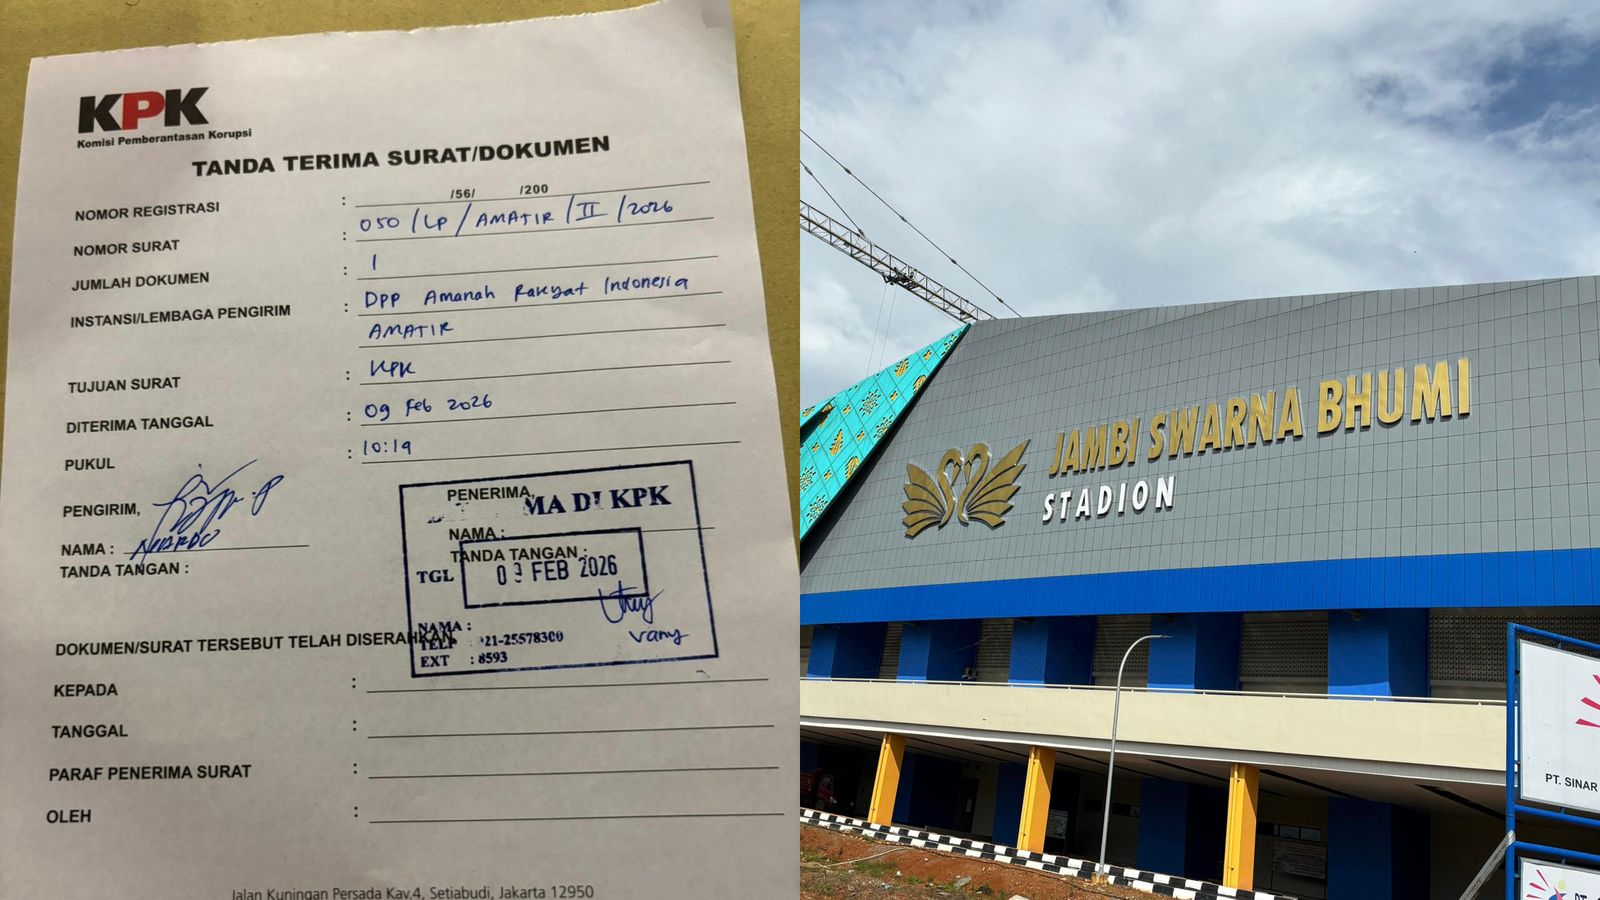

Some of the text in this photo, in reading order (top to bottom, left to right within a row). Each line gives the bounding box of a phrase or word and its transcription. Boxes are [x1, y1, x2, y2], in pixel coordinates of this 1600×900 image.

[78, 87, 210, 134] KPK
[76, 128, 252, 149] Komisi Pemberantasan Korupsi
[192, 135, 610, 177] TANDA TERIMA SURAT/DOKUMEN
[75, 207, 129, 222] NOMOR
[132, 201, 220, 218] REGISTRASI
[450, 188, 476, 200] /56/
[519, 184, 549, 195] /200
[73, 243, 128, 257] NOMOR
[131, 239, 180, 253] SURAT
[71, 277, 131, 292] JUMLAH
[135, 271, 210, 288] DOKUMEN
[423, 285, 496, 306] Amanah
[603, 275, 689, 293] Indonesia
[70, 309, 214, 328] INSTANSI/LEMBAGA
[217, 304, 291, 319] PENGIRIM
[368, 321, 455, 340] AMATIR
[68, 380, 126, 394] TUJUAN
[131, 376, 181, 390] SURAT
[365, 403, 390, 421] 09
[447, 394, 493, 412] 2026
[66, 419, 137, 434] DITERIMA
[141, 415, 214, 431] TANGGAL
[1048, 357, 1473, 478] JAMBI SWARNA BHUMI
[65, 457, 115, 471] PUKUL
[447, 485, 534, 502] PENERIMA,
[611, 484, 671, 509] KPK
[1042, 475, 1176, 522] STADION
[62, 502, 140, 517] PENGIRIM,
[449, 528, 496, 541] NAMA
[61, 543, 105, 556] NAMA
[450, 549, 505, 563] TANDA
[509, 545, 578, 561] TANGAN
[60, 564, 111, 578] TANDA
[115, 561, 180, 576] TANGAN
[416, 570, 454, 583] TGL
[532, 560, 569, 582] FEB
[579, 555, 618, 578] 2026
[418, 621, 463, 634] NAMA
[56, 640, 193, 656] DOKUMEN/SURAT
[197, 637, 283, 652] TERSEBUT
[287, 634, 341, 648] TELAH
[420, 655, 450, 668] EXT
[478, 652, 508, 664] 8593
[54, 684, 118, 697] KEPADA
[52, 725, 128, 738] TANGGAL
[49, 767, 103, 782] PARAF
[108, 766, 192, 780] PENERIMA
[197, 764, 252, 778] SURAT
[1545, 773, 1598, 791] PT. SINAR
[46, 810, 92, 824] OLEH
[231, 888, 262, 900] Jalan
[267, 888, 329, 900] Kuningan
[333, 887, 383, 900] Persada
[430, 885, 495, 900] Setiabudi,
[499, 885, 546, 899] Jakarta
[551, 885, 594, 899] 12950
